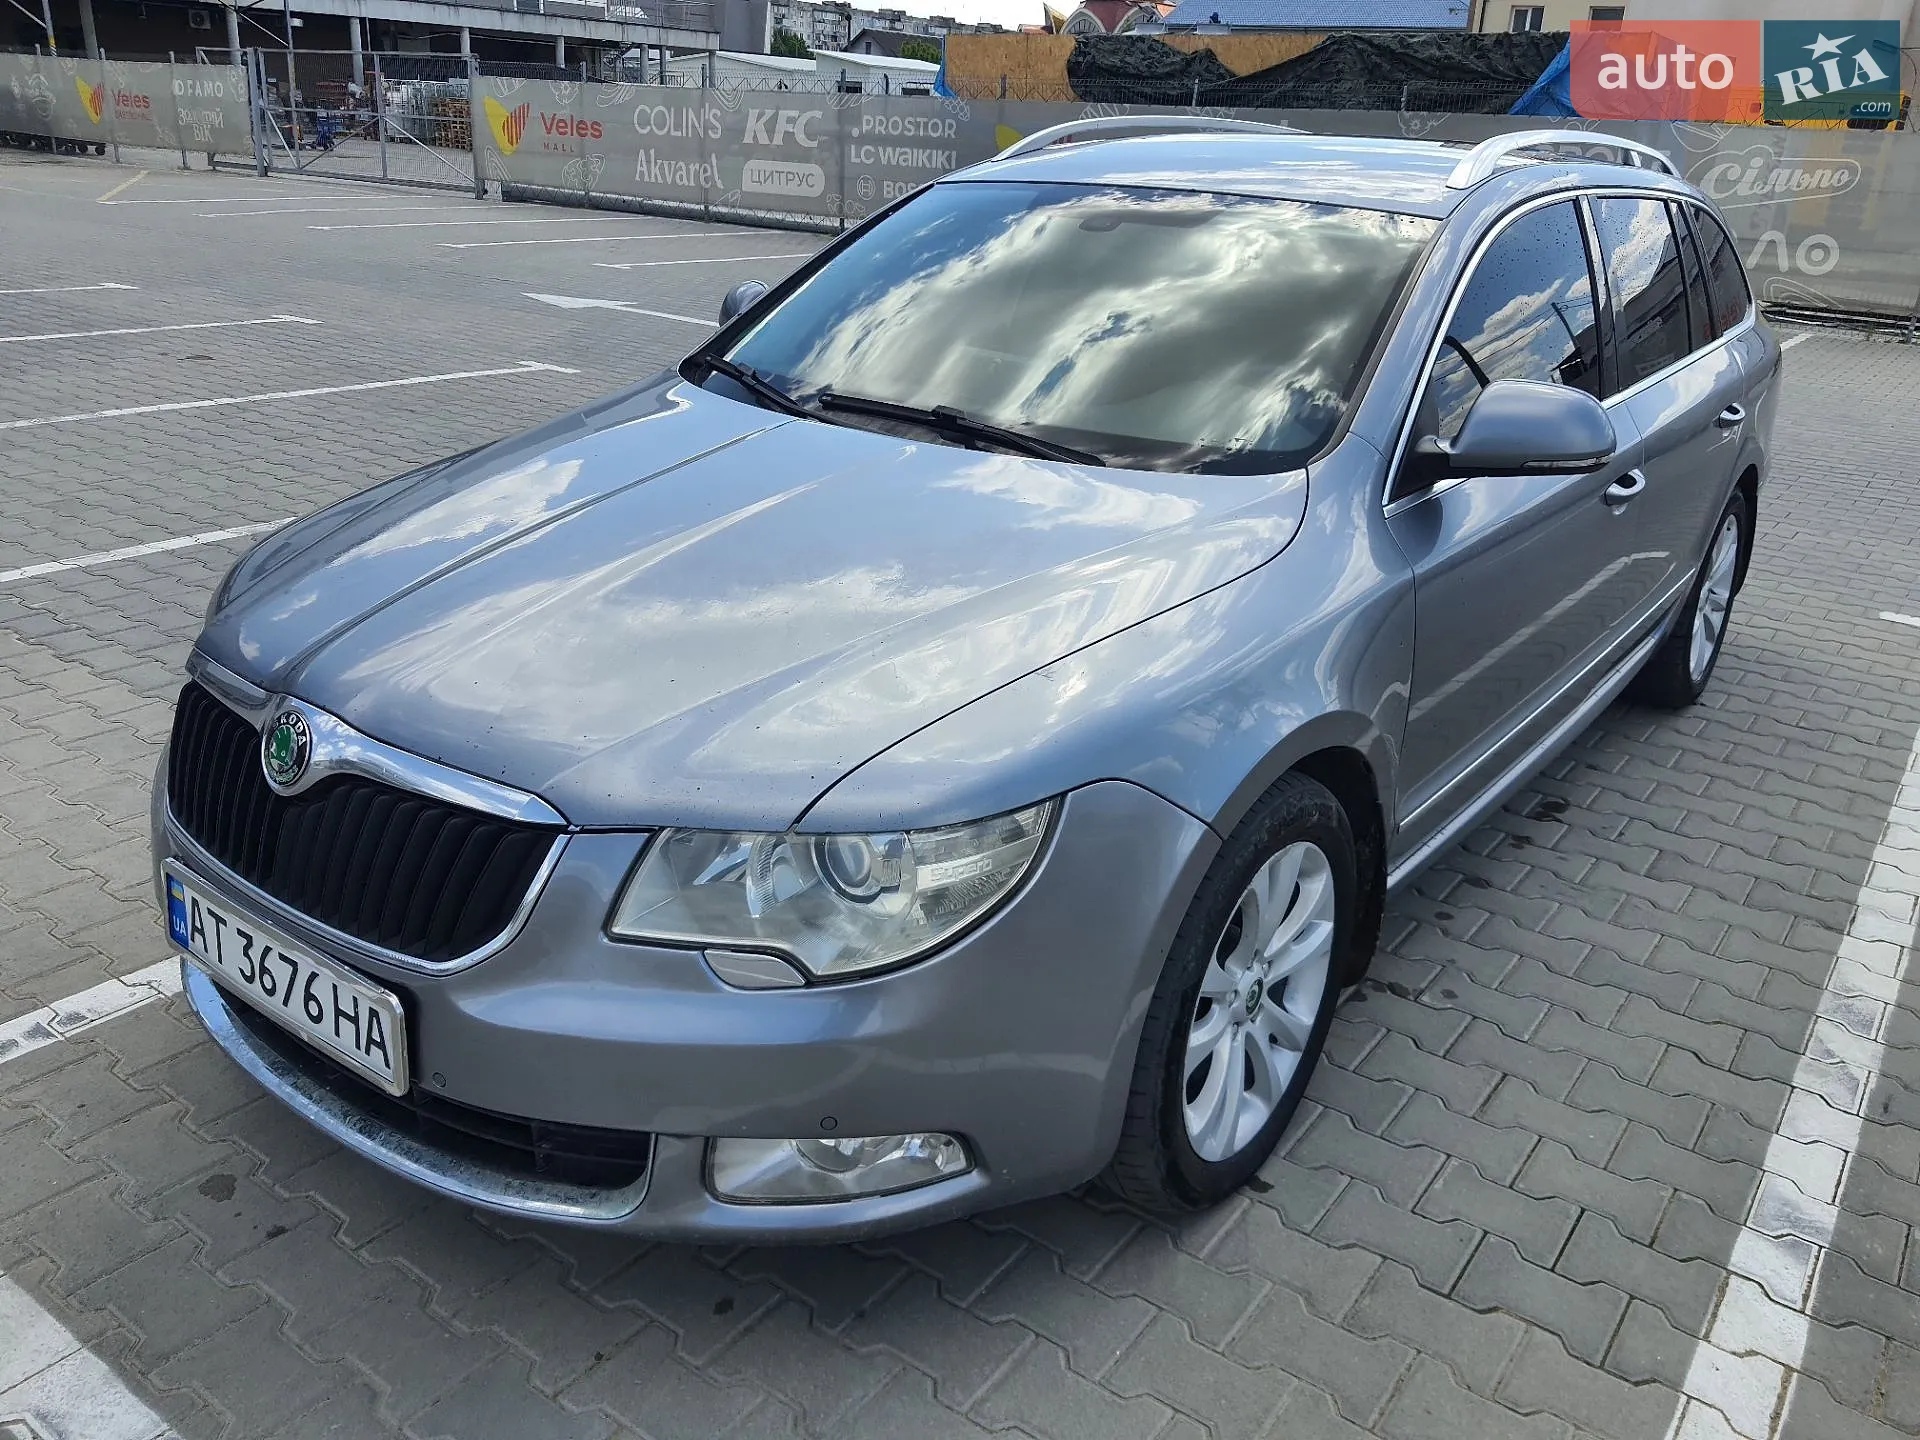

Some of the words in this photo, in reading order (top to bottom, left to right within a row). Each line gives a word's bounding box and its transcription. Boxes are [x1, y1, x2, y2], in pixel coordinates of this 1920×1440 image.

[112, 89, 151, 109] Veles
[540, 111, 603, 139] Veles
[633, 103, 722, 139] COLIN'S
[742, 108, 824, 148] KFC
[543, 142, 575, 153] MALL
[850, 145, 875, 165] LC
[635, 148, 724, 189] Akvarel
[750, 168, 816, 189] ЦИТРУС
[172, 915, 187, 937] UA
[190, 896, 228, 965] AT
[236, 927, 324, 1025] 3676
[331, 983, 391, 1070] HA
